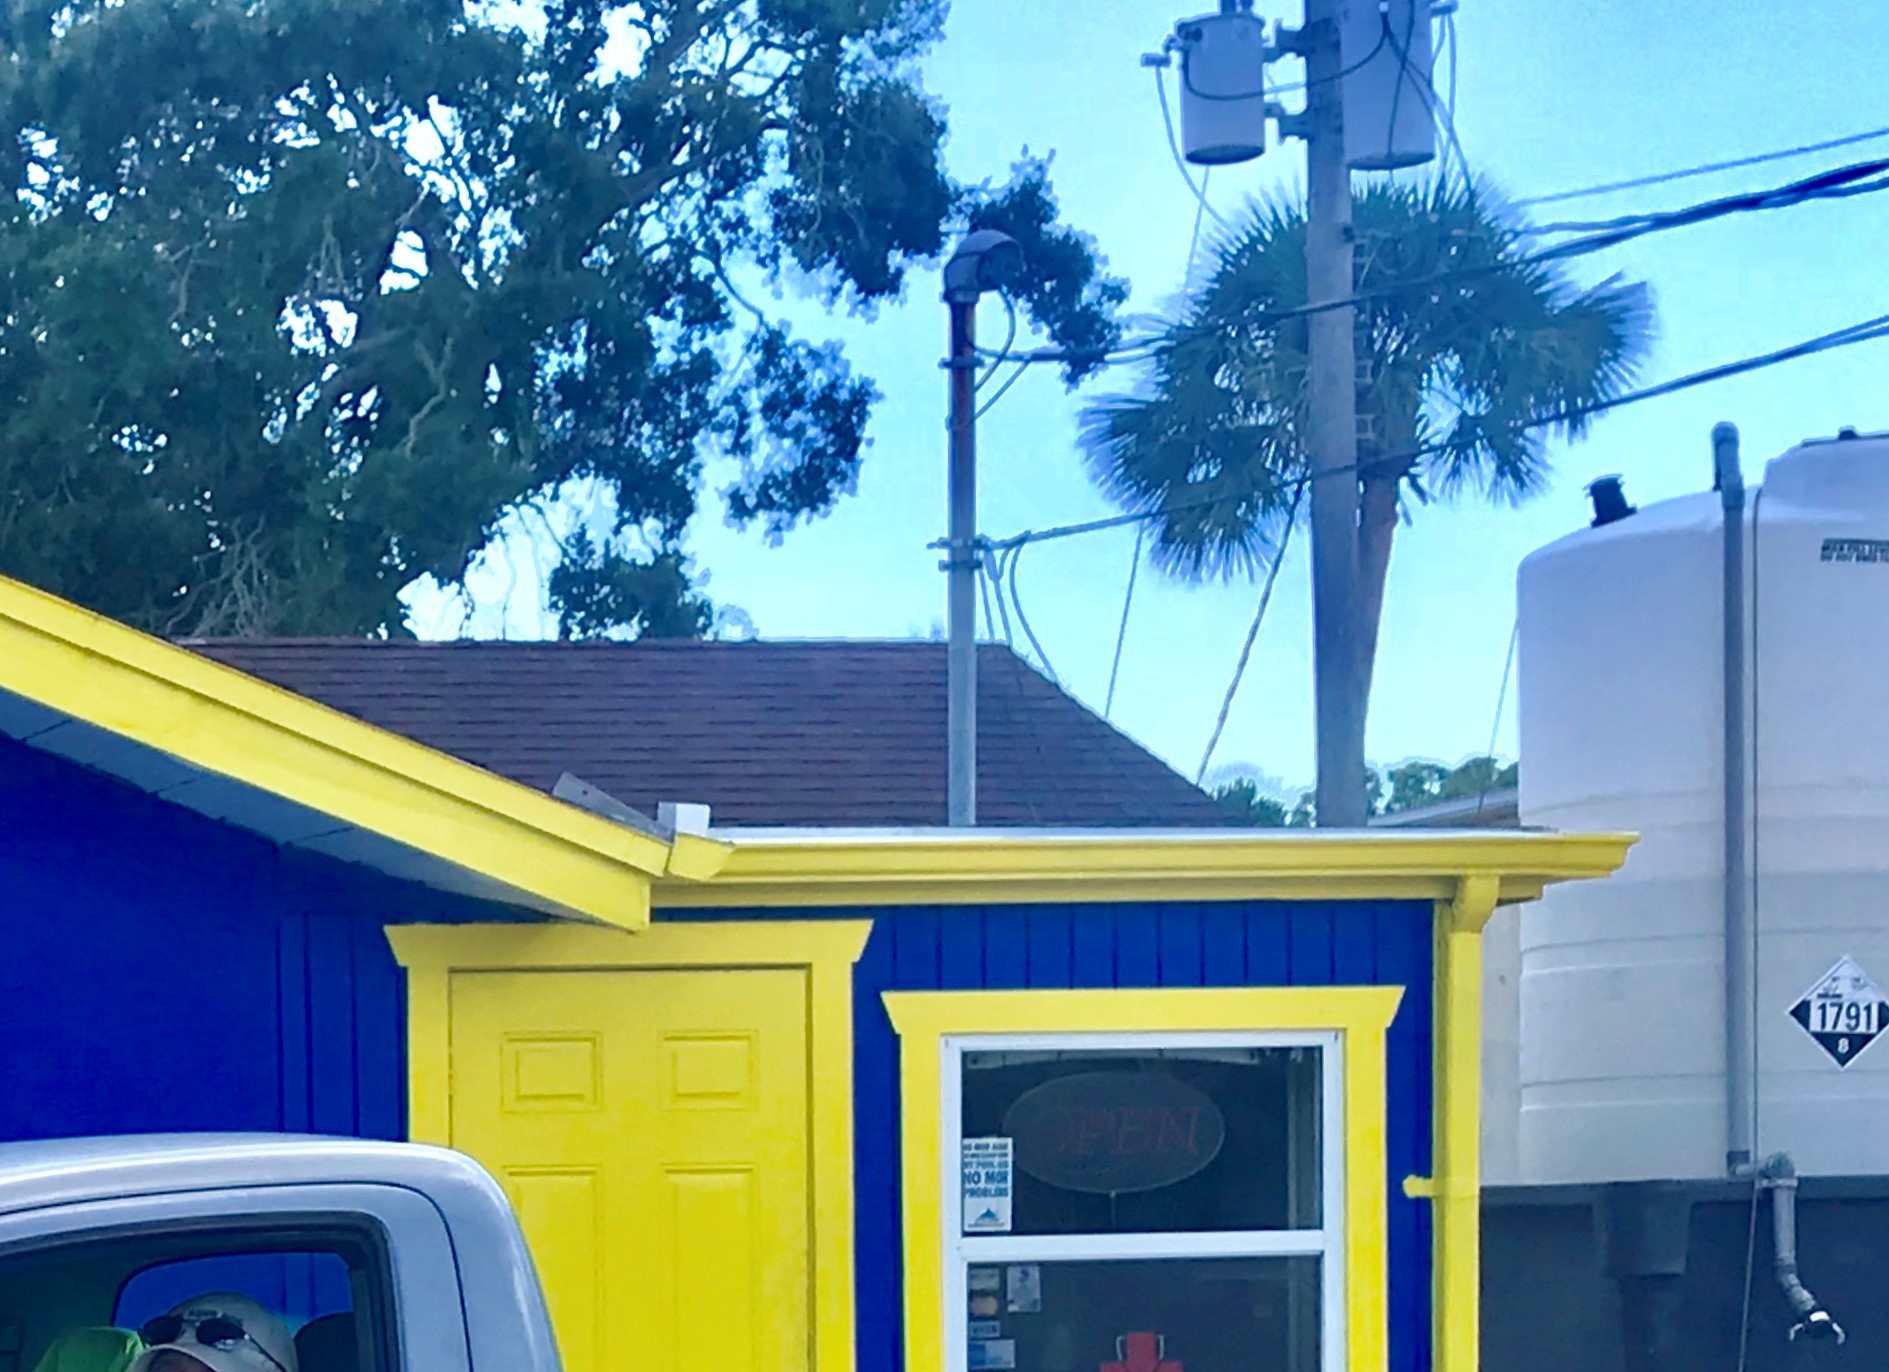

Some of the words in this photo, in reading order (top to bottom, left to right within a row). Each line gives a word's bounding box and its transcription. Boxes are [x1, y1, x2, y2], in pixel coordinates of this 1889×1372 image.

[1817, 1001, 1872, 1031] 1791
[1837, 1037, 1850, 1054] 8
[1026, 1104, 1203, 1158] PEN
